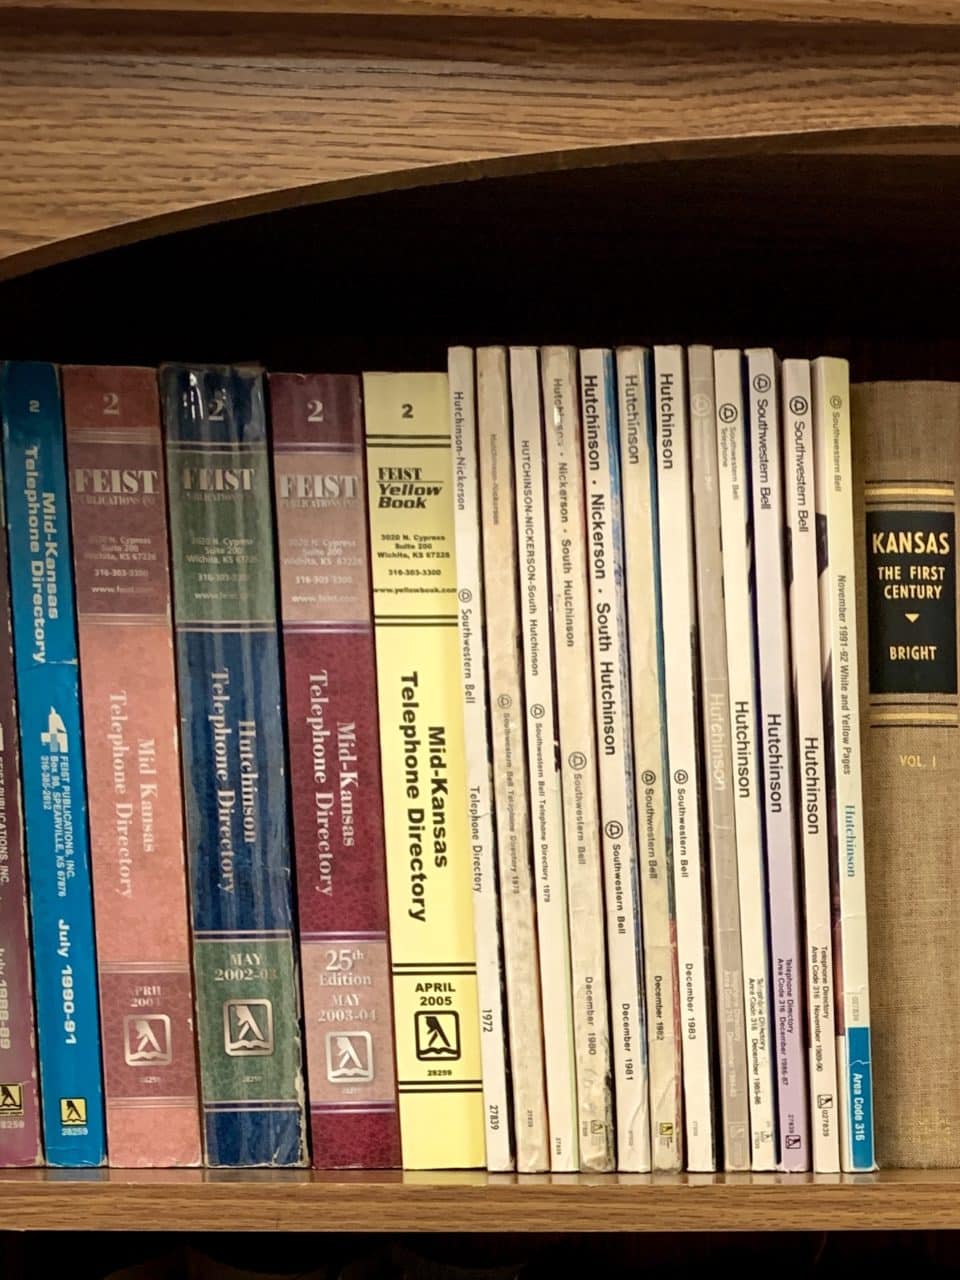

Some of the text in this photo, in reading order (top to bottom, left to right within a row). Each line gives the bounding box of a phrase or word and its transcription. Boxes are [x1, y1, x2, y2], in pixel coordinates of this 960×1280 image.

[103, 394, 119, 414] 2
[307, 401, 323, 422] 2
[402, 404, 413, 418] 2
[625, 375, 640, 464] Hutchinson
[659, 373, 675, 469] Hutchinson
[74, 470, 159, 494] FEIST
[280, 475, 358, 498] FEIST
[378, 468, 422, 480] FEIST
[378, 484, 442, 496] Yellow
[454, 392, 466, 511] Hutchinson-Nickerson
[757, 399, 771, 510] Southwestern Bell
[793, 421, 808, 533] Southwestern Bell
[378, 496, 427, 509] Book
[25, 446, 46, 664] Telephone Directory
[42, 493, 58, 619] Mid-Kansas
[584, 375, 617, 755] Hutchinson Nickerson South Hutchinson
[873, 532, 949, 554] KANSAS
[878, 566, 945, 580] THE FIRST
[885, 585, 942, 599] CENTURY
[890, 646, 936, 660] BRIGHT
[735, 701, 751, 798] Hutchinson
[767, 713, 784, 813] Hutchinson
[803, 737, 820, 834] Hutchinson
[932, 757, 936, 768] I
[60, 756, 74, 878] FEIST PUBLICATIONS, INC.
[107, 691, 133, 899] Telephone Directory
[137, 738, 157, 853] Mid Kansas
[400, 672, 427, 922] Telephone Directory
[427, 727, 449, 868] Mid-Kansas
[843, 804, 858, 877] Hutchinson
[612, 844, 626, 934] Southwestern Bell
[57, 920, 77, 1044] July 1990-91
[415, 983, 456, 992] APRIL
[420, 996, 452, 1006] 2005
[482, 1009, 492, 1032] 1972
[622, 1003, 634, 1081] December 1981
[853, 1073, 866, 1140] Area Code 316
